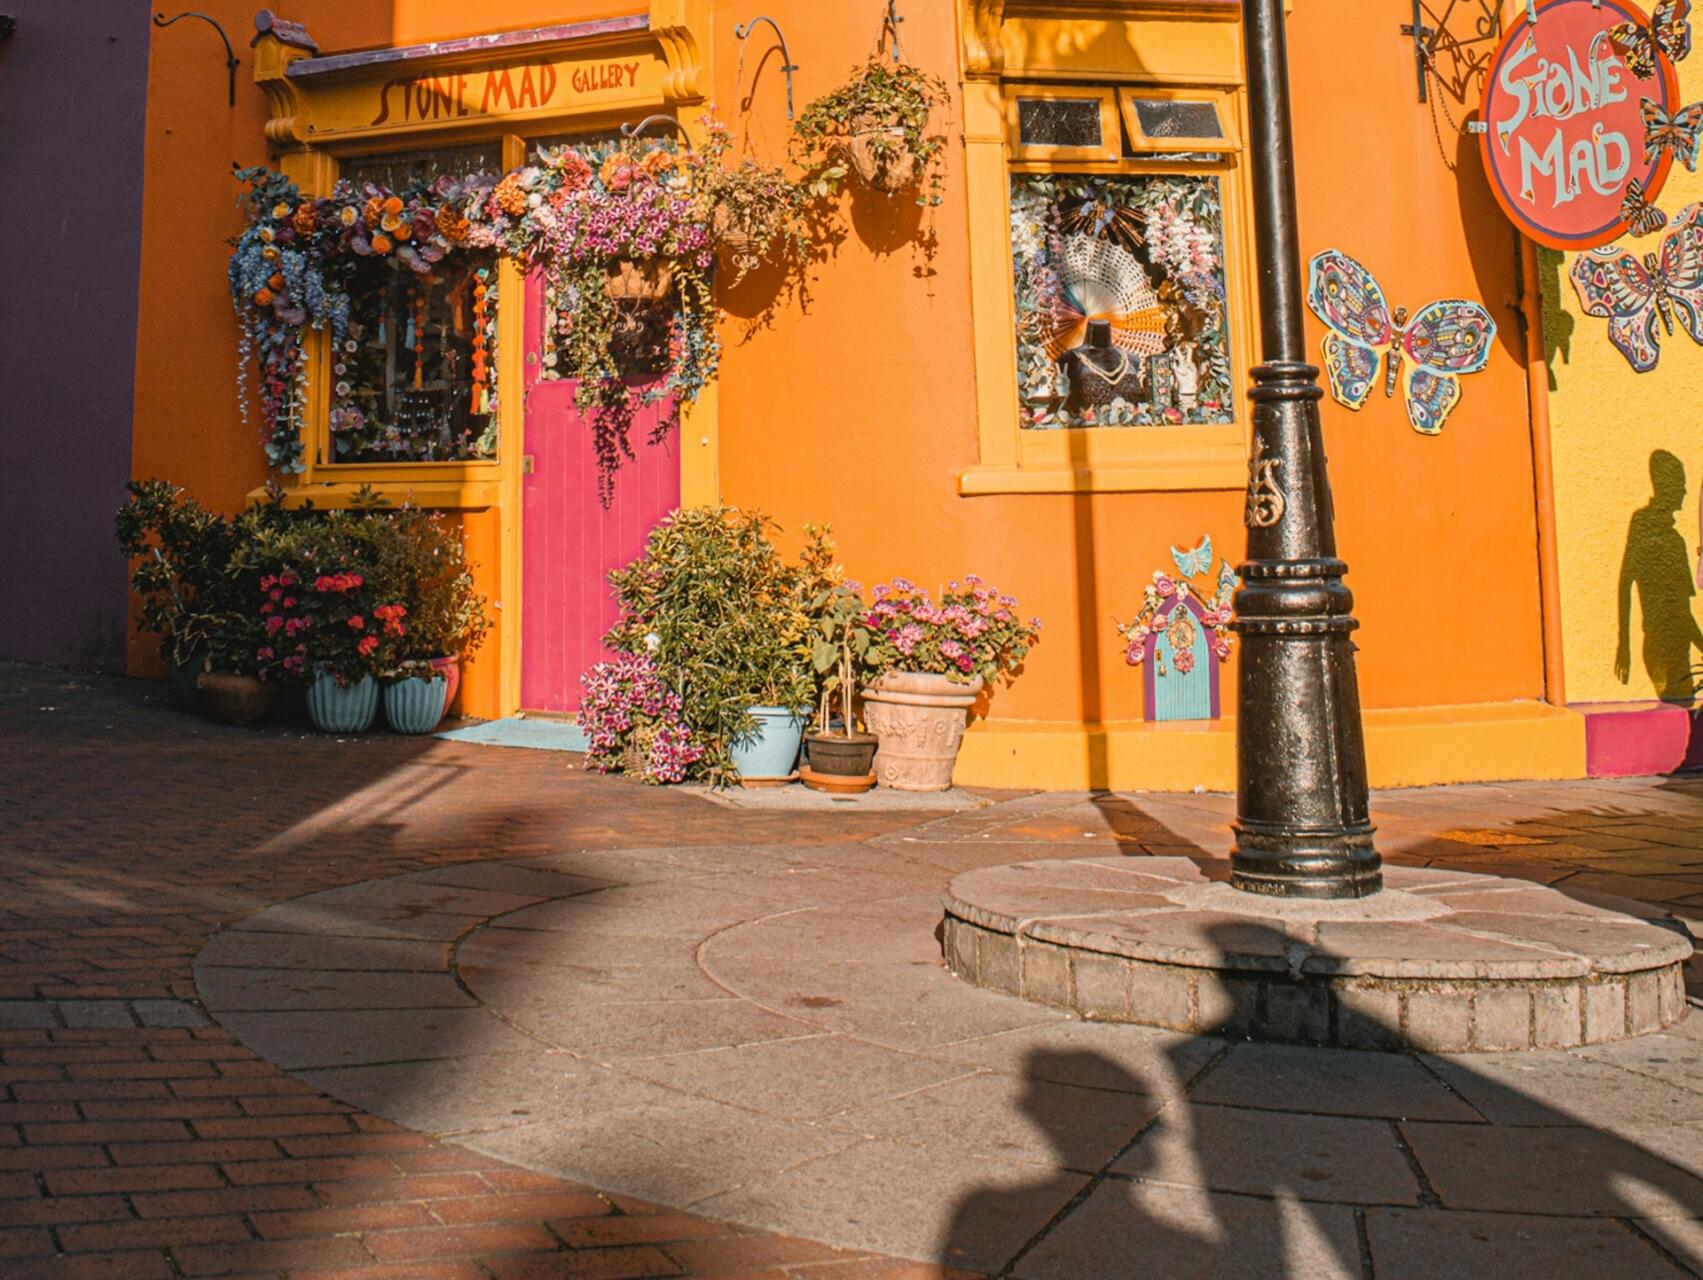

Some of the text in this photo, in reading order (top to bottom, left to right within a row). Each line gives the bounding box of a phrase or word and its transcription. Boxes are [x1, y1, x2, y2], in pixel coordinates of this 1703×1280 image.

[371, 58, 640, 126] STONE MAD GALLERY
[1497, 29, 1628, 156] STONE
[1517, 122, 1631, 208] MAD
